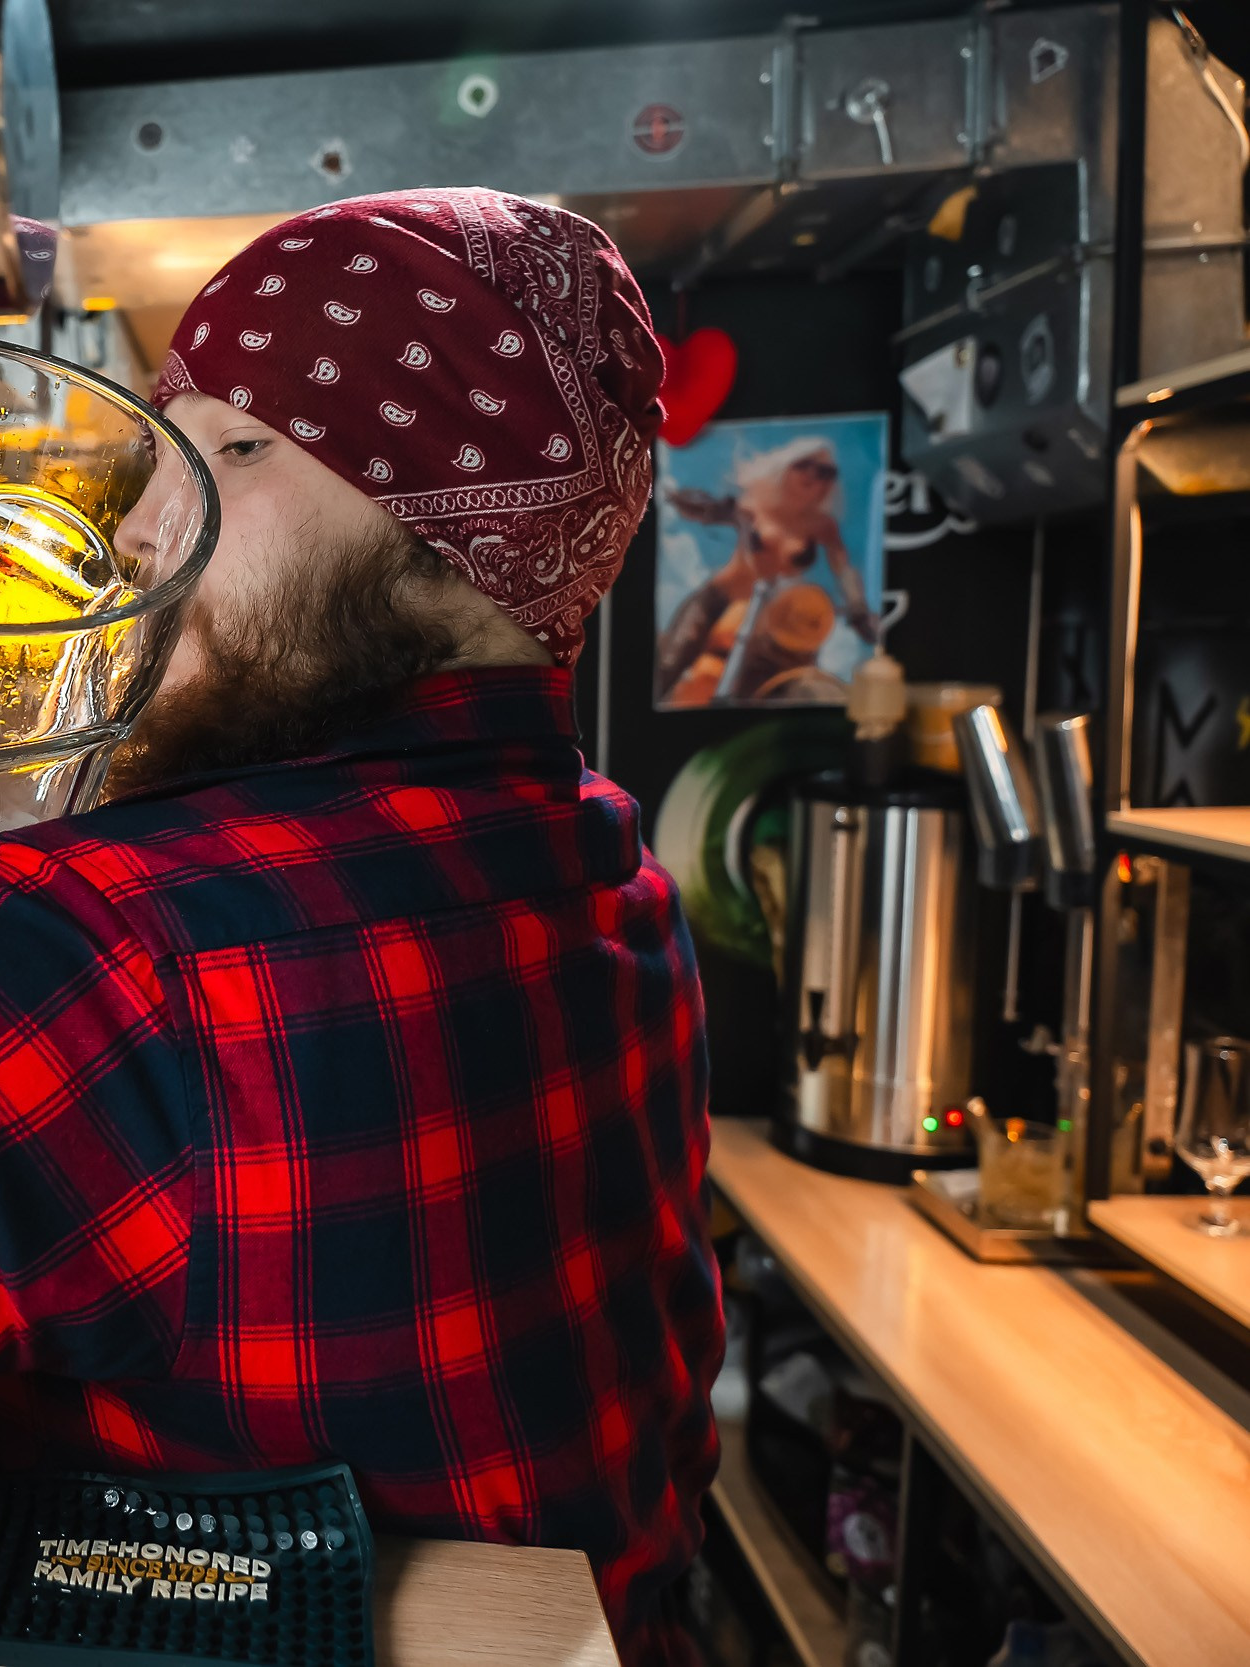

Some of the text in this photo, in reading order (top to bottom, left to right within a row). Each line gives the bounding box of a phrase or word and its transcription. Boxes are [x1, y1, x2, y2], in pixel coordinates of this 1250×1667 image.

[40, 1539, 271, 1578] TIME-HONORED
[86, 1556, 163, 1579] SINCE
[33, 1560, 268, 1602] FAMILY RECIPE
